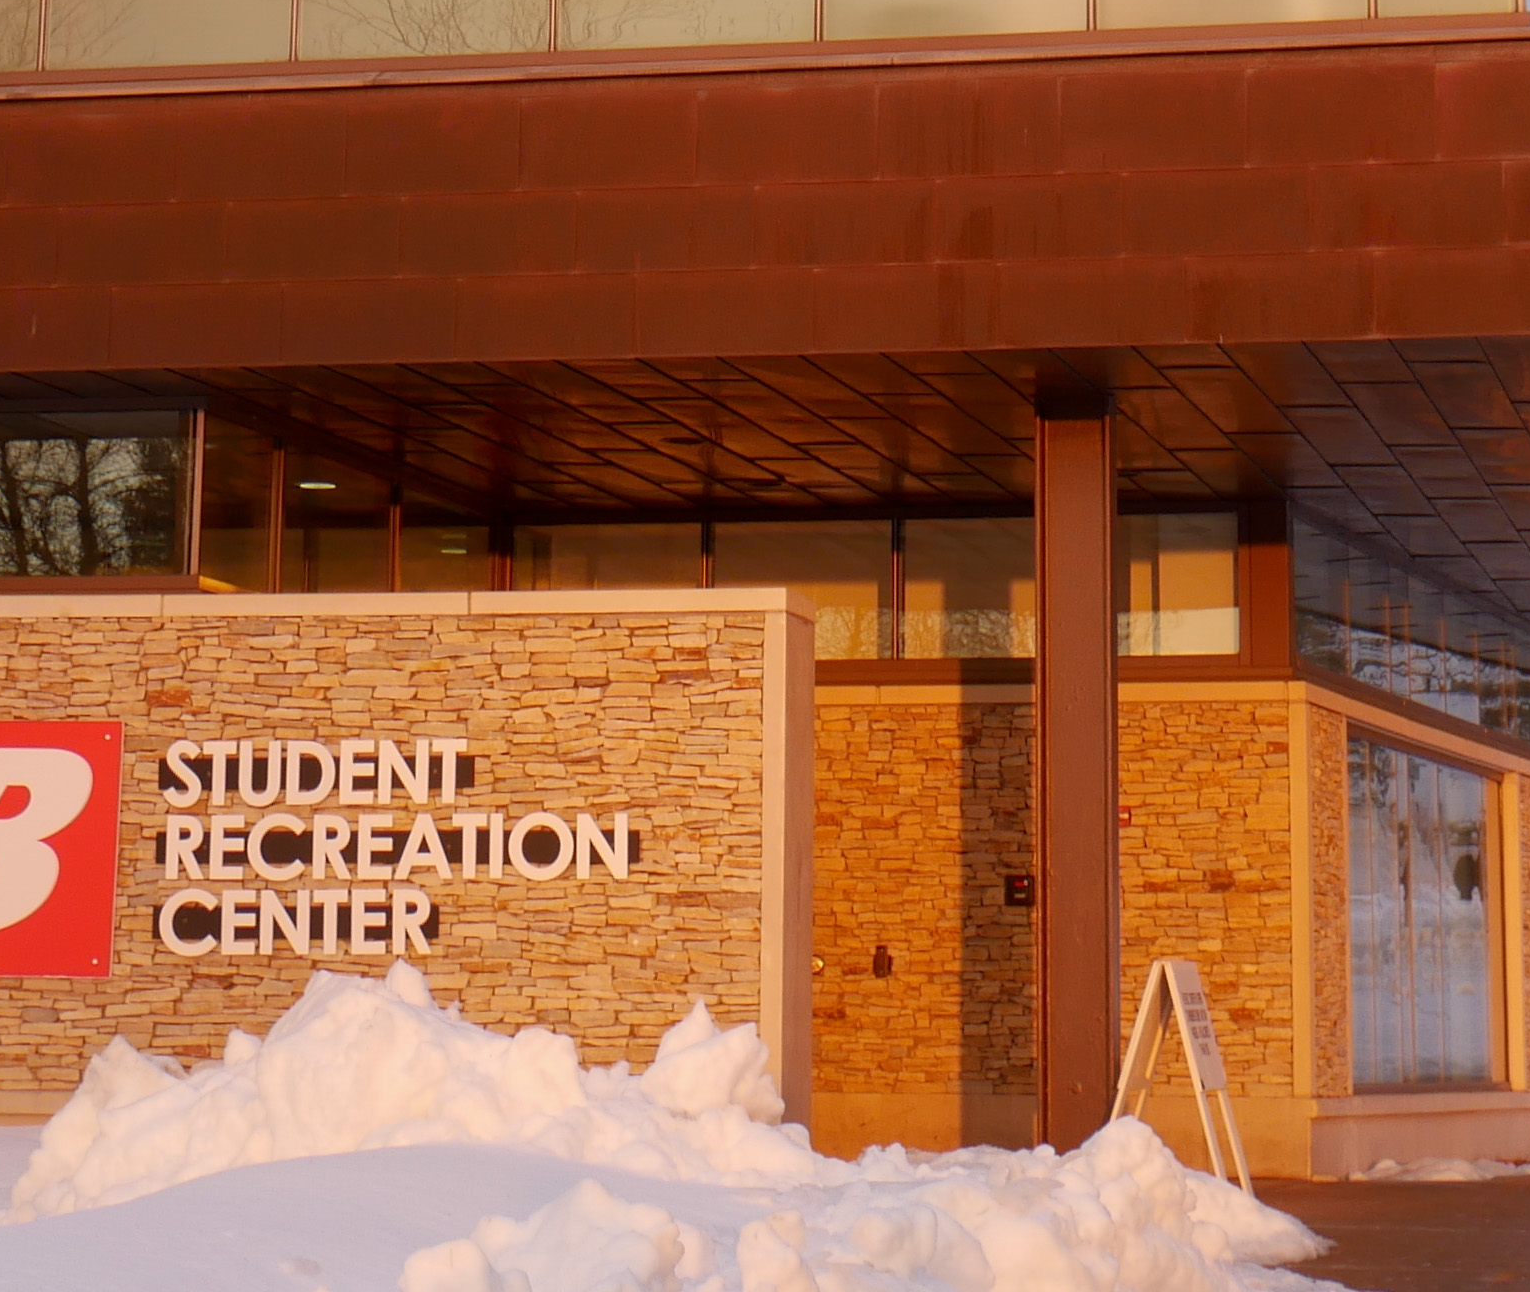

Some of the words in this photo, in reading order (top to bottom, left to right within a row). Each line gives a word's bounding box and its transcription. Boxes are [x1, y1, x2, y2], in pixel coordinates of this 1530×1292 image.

[163, 738, 468, 807] STUDENT
[165, 811, 629, 881] RECREATION
[159, 888, 432, 957] CENTER
